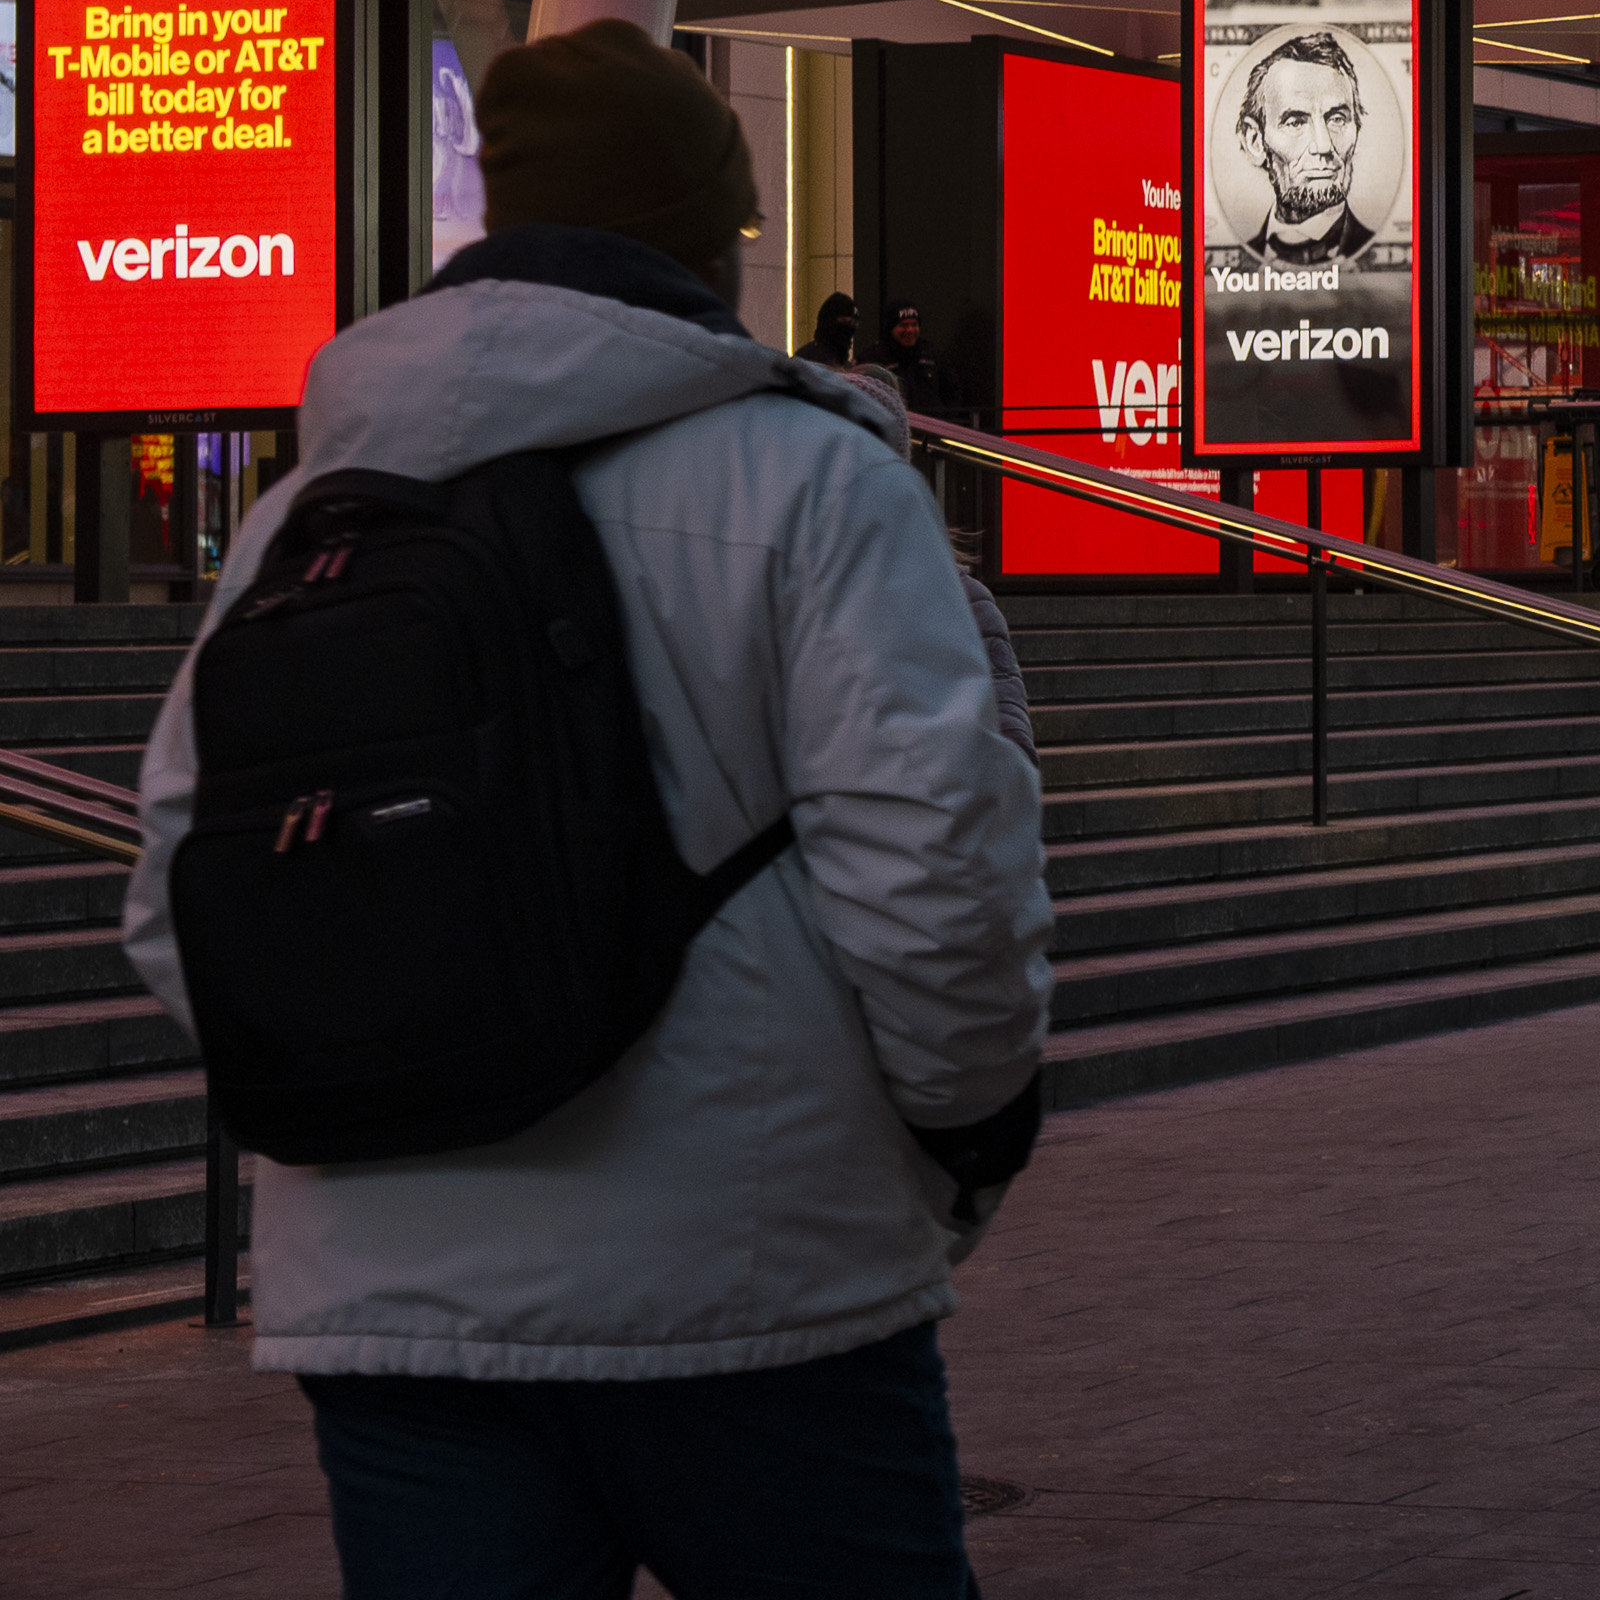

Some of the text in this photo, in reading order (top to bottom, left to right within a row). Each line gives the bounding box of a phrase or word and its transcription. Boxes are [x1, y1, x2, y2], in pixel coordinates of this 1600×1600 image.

[85, 3, 287, 43] Bring in your
[48, 44, 190, 79] T-Mobile
[194, 48, 230, 74] or
[234, 37, 324, 73] AT&T
[87, 78, 287, 118] bill today for
[82, 115, 292, 154] a better deal.
[1142, 179, 1164, 208] You
[77, 224, 294, 281] verizon
[1094, 217, 1137, 267] Bring
[1138, 223, 1154, 261] in
[1155, 233, 1181, 269] you
[1089, 263, 1181, 308] AT&T bill for
[1210, 264, 1340, 293] You heard
[1226, 319, 1390, 362] verizon
